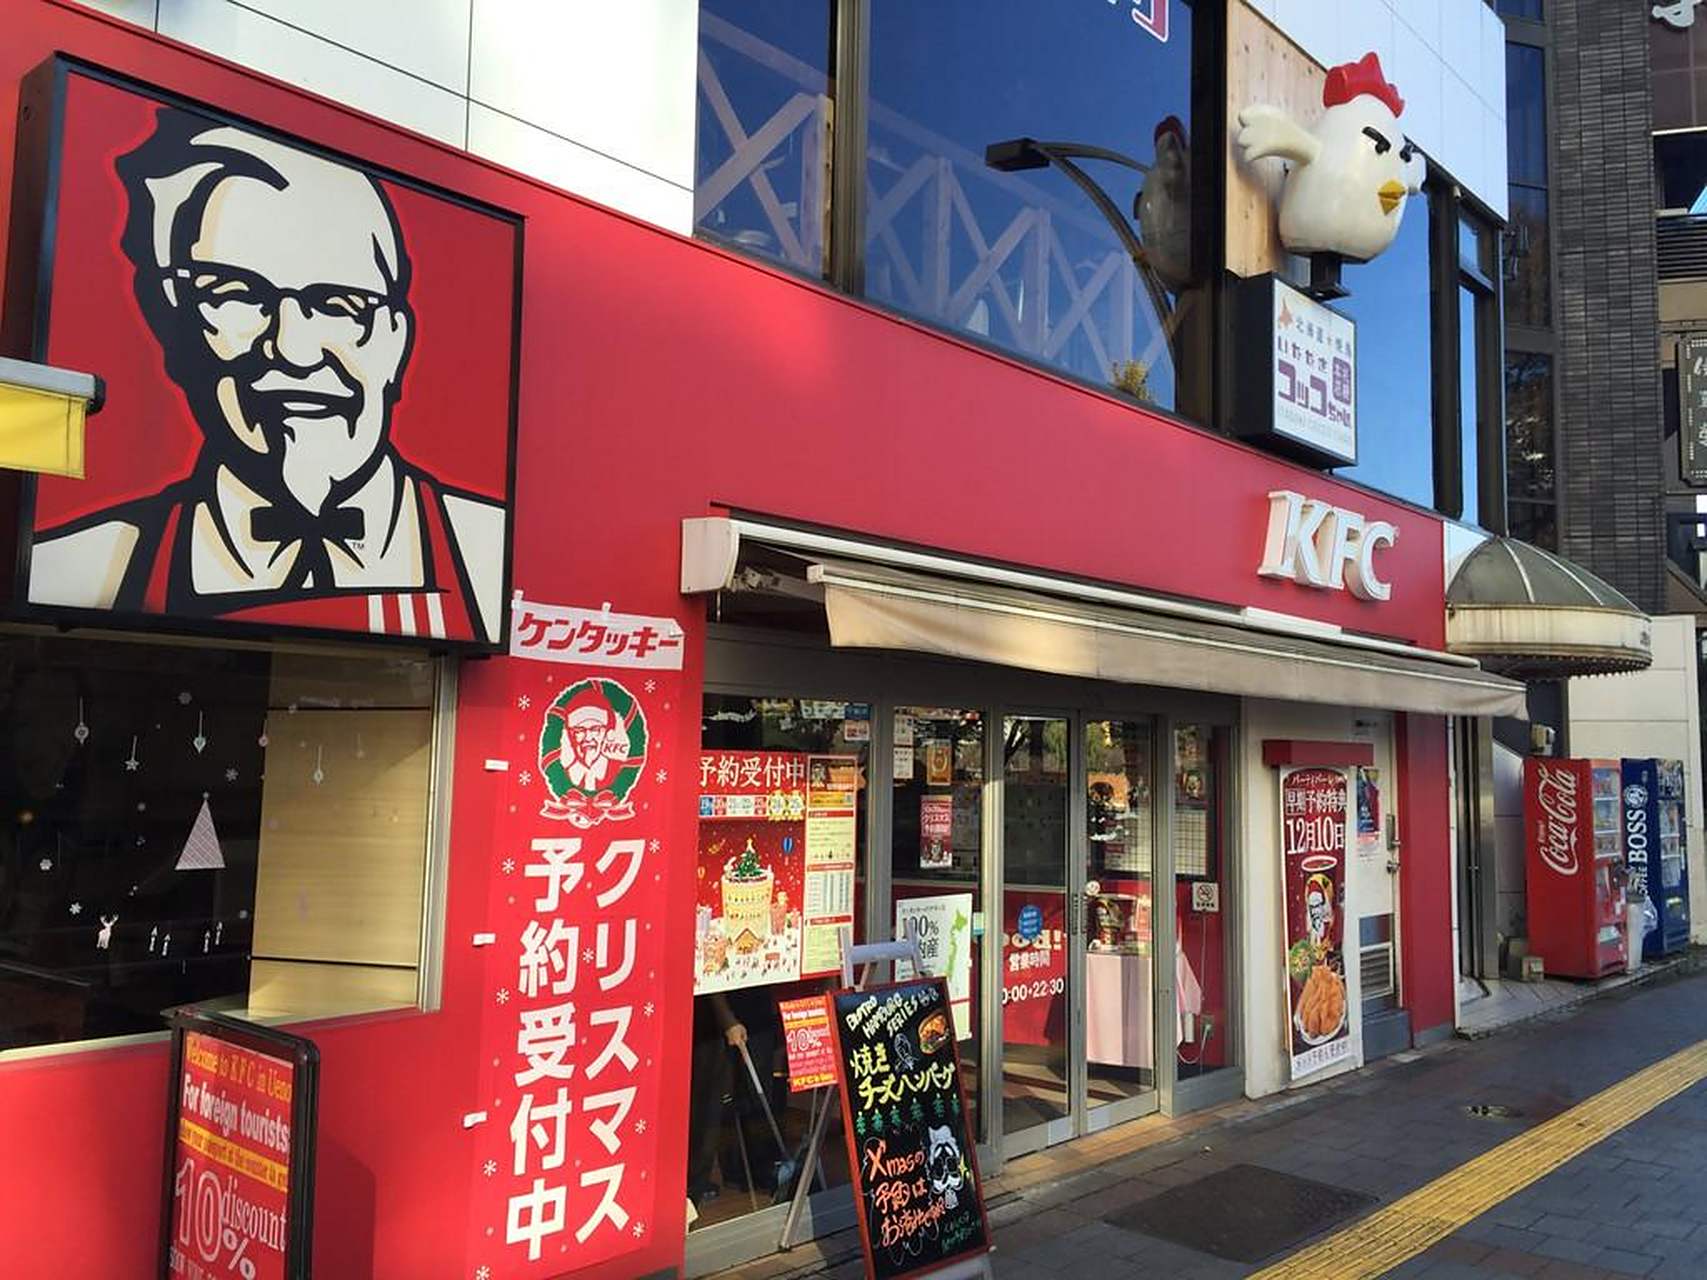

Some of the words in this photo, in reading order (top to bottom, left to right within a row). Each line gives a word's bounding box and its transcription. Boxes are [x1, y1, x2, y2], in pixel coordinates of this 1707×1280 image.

[1258, 489, 1399, 601] KFC
[518, 612, 679, 658] ケンタッキー
[603, 742, 629, 754] KFC
[699, 755, 805, 788] 予約受付中
[1286, 816, 1345, 854] 12月10日
[1627, 809, 1648, 865] BOSS
[576, 838, 647, 1245] クリスマス
[886, 994, 919, 1038] SERIES
[506, 837, 585, 1262] 予約受付中
[849, 1042, 891, 1079] 焼き
[183, 1072, 200, 1113] For
[200, 1081, 239, 1137] foreign
[240, 1100, 290, 1153] tourists
[221, 1174, 287, 1254] discount
